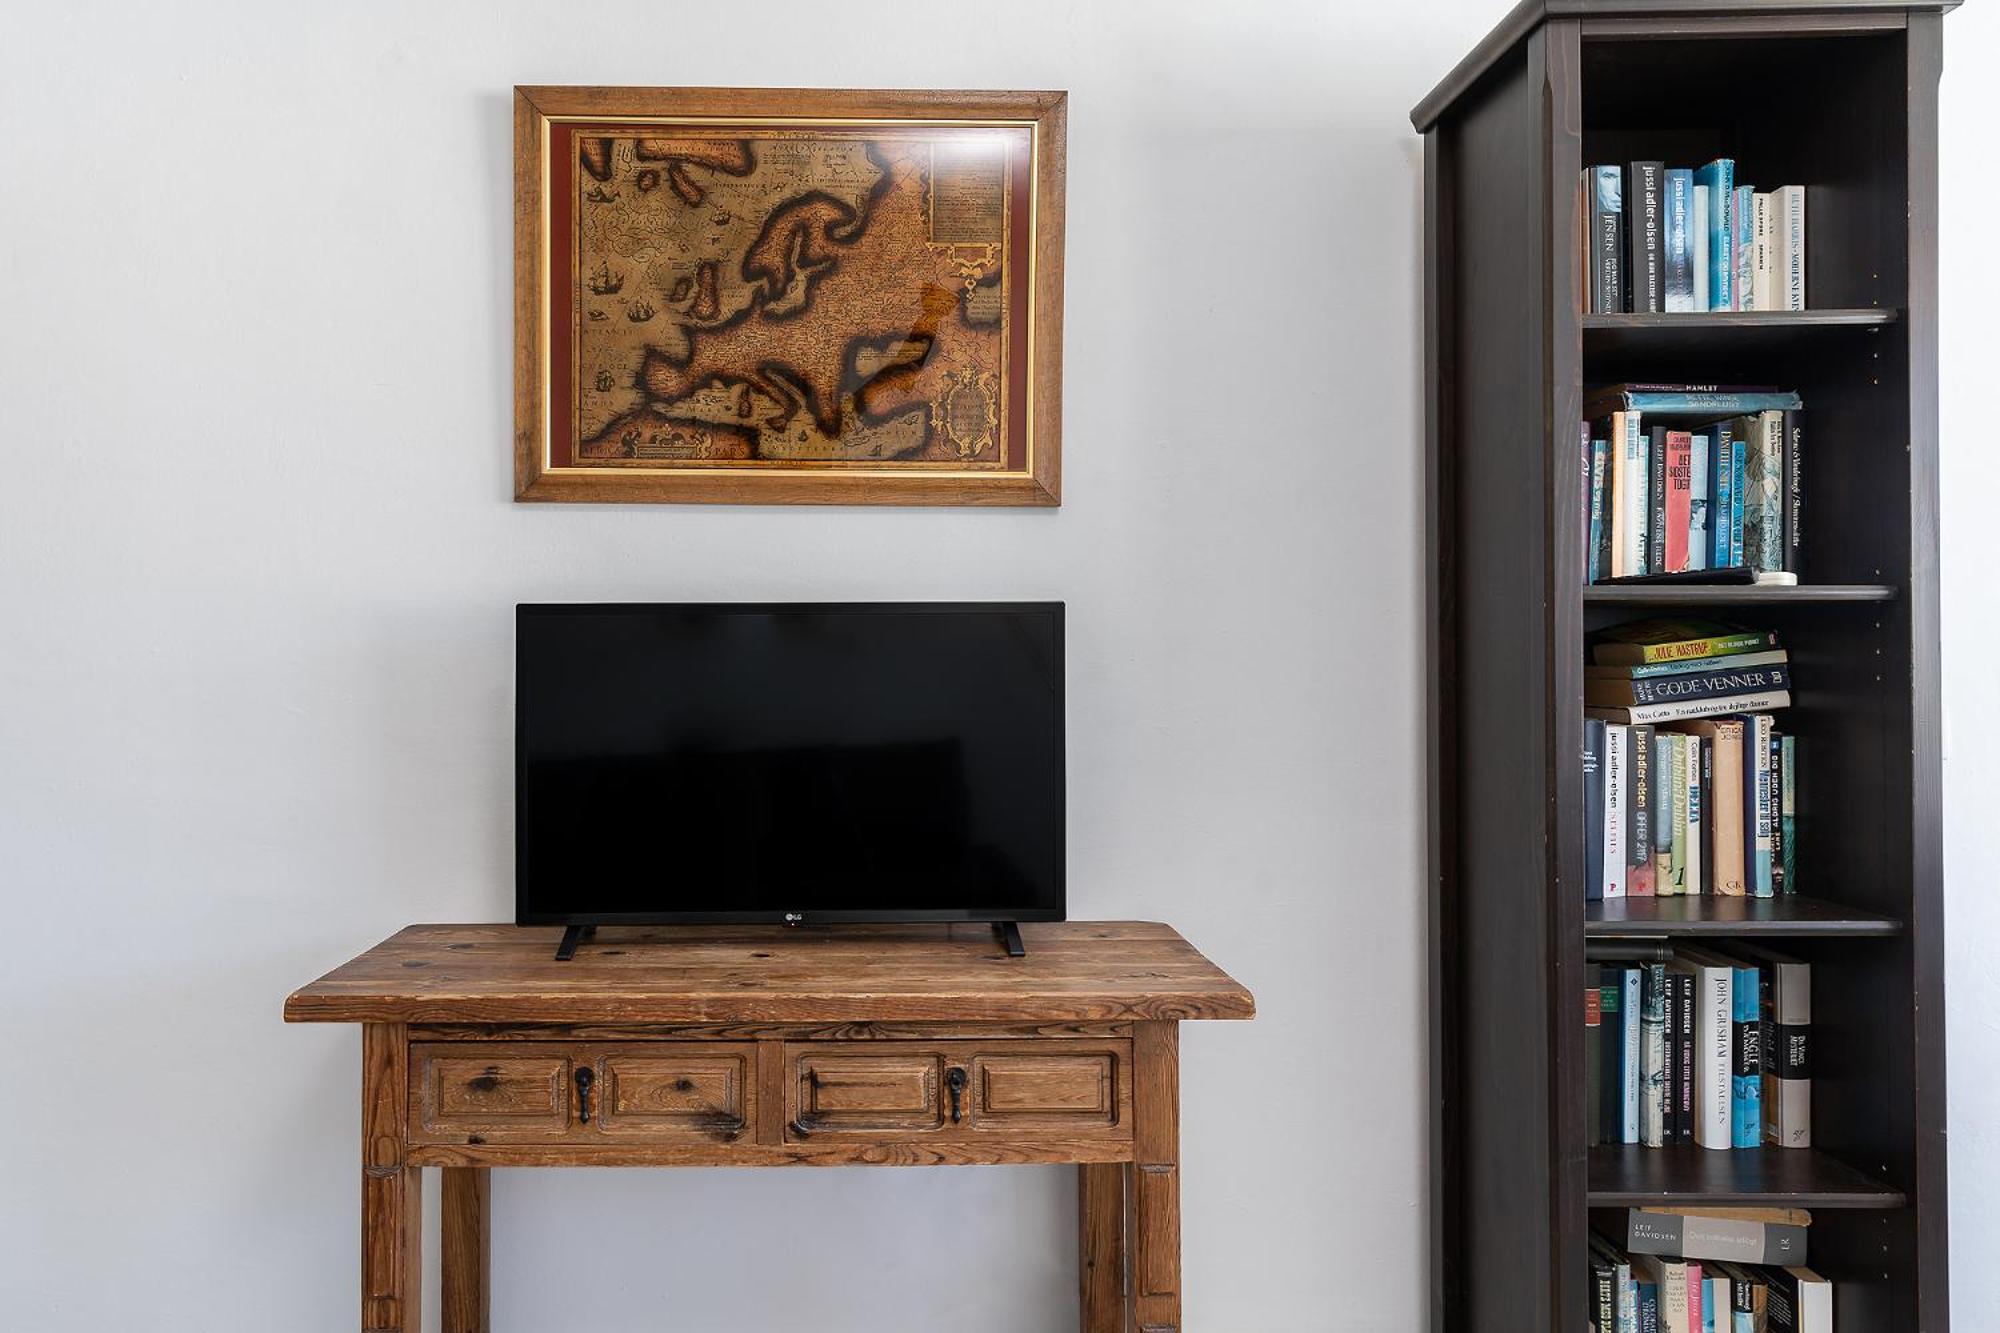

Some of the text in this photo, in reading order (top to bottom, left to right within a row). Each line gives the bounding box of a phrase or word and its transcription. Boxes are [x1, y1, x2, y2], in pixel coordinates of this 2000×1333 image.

[1643, 166, 1656, 190] jussi
[1673, 177, 1685, 199] jussi
[1604, 215, 1616, 252] JENSEN
[1646, 192, 1657, 250] adler-olsen
[1675, 201, 1686, 254] adler-olsen
[1594, 450, 1605, 488] ELVIS
[1656, 679, 1701, 696] GODE
[1703, 672, 1767, 690] VENNER
[1609, 732, 1619, 754] jussi
[1610, 755, 1619, 808] adler-olsen
[1636, 730, 1648, 862] jussi adler-olsen OFFER 2117
[1760, 770, 1770, 812] Mennesker
[1689, 784, 1699, 824] DELTA
[1757, 822, 1770, 838] salg
[1664, 979, 1672, 996] LEIF
[1683, 979, 1691, 996] LEIF
[1714, 978, 1728, 1005] JOHN
[1664, 999, 1672, 1034] DAVIDSEN
[1683, 999, 1691, 1034] DAVIDSEN
[1716, 1009, 1727, 1058] GRISHAM
[1748, 1031, 1759, 1064] ENGLE
[1634, 1231, 1677, 1241] DAVIDSEN
